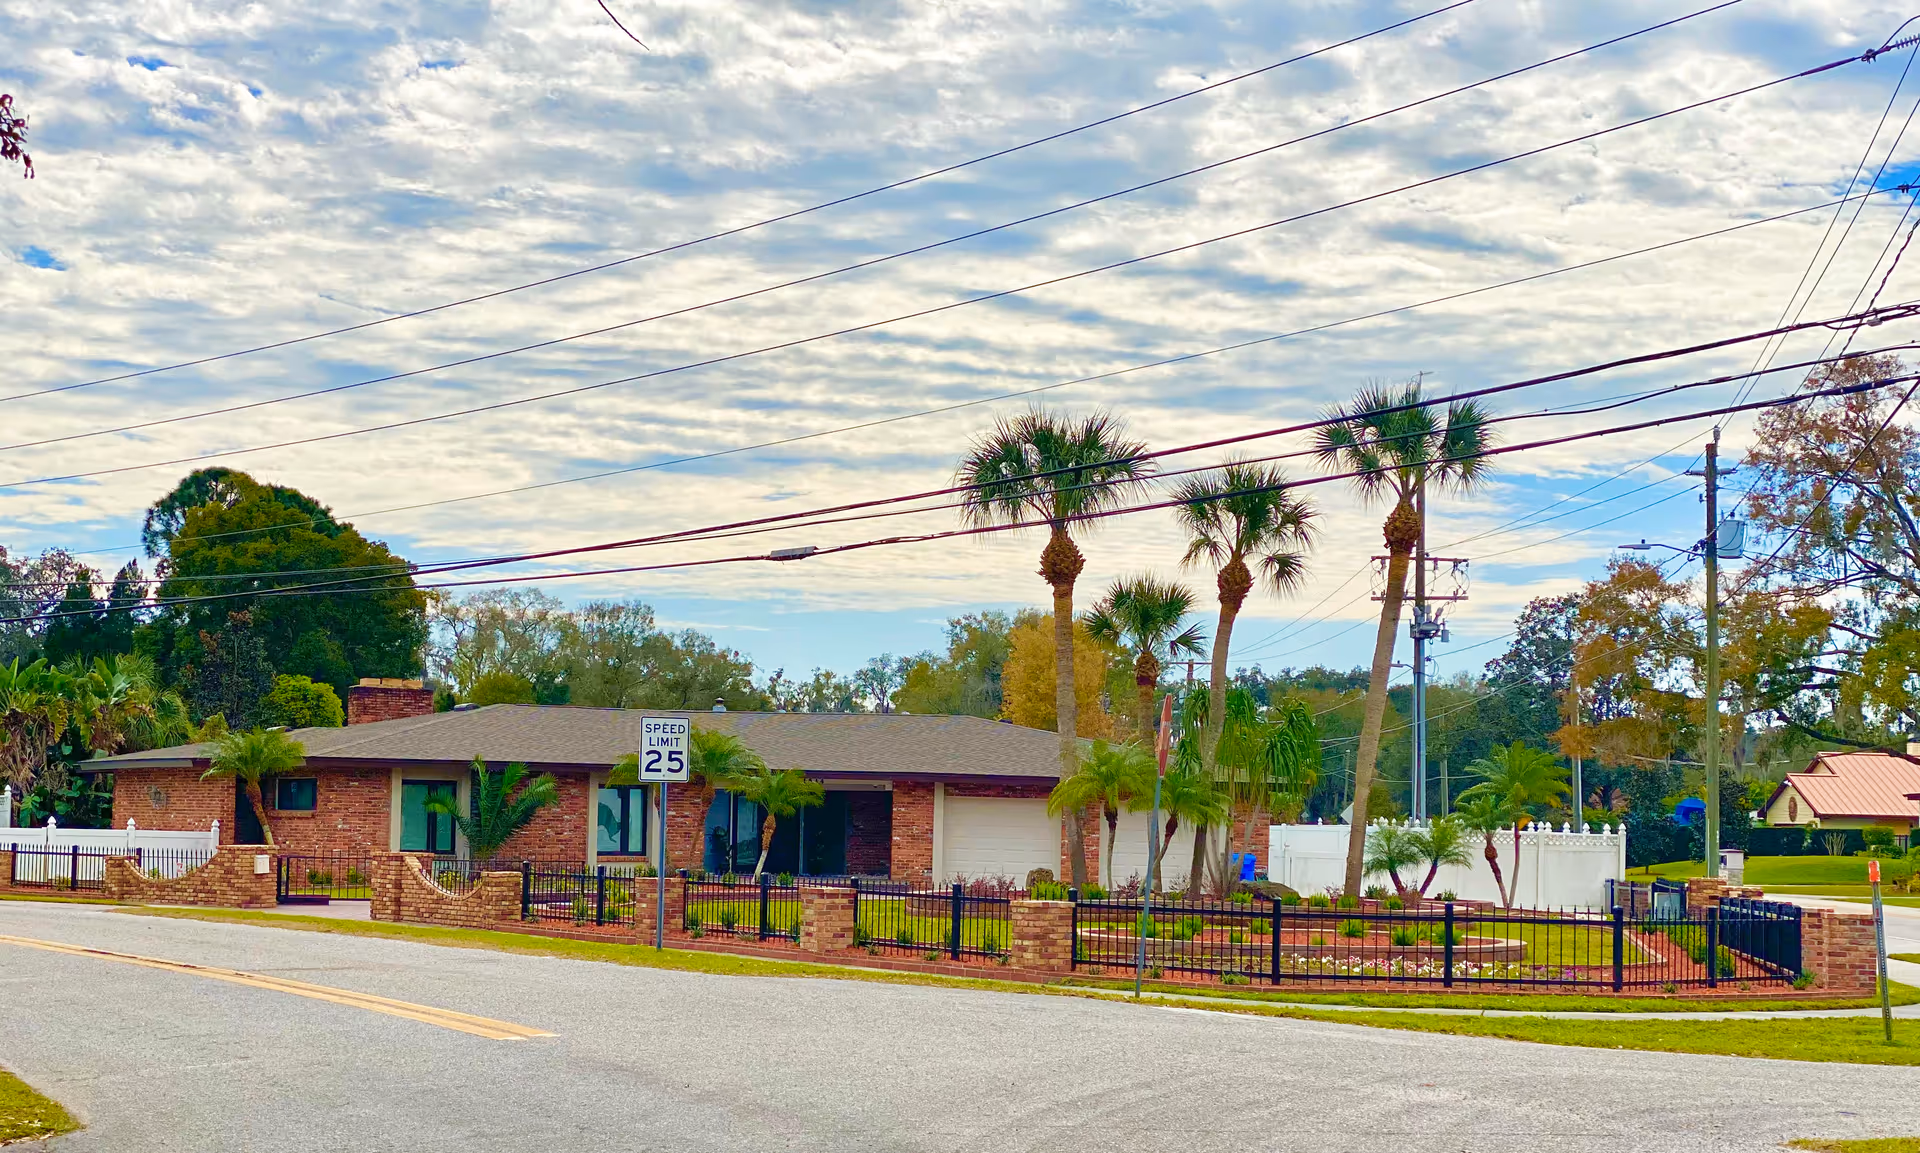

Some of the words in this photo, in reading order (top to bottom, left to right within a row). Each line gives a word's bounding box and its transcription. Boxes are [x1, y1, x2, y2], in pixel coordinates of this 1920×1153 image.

[645, 723, 686, 734] SPEED
[649, 736, 681, 747] LIMIT
[644, 749, 684, 774] 25
